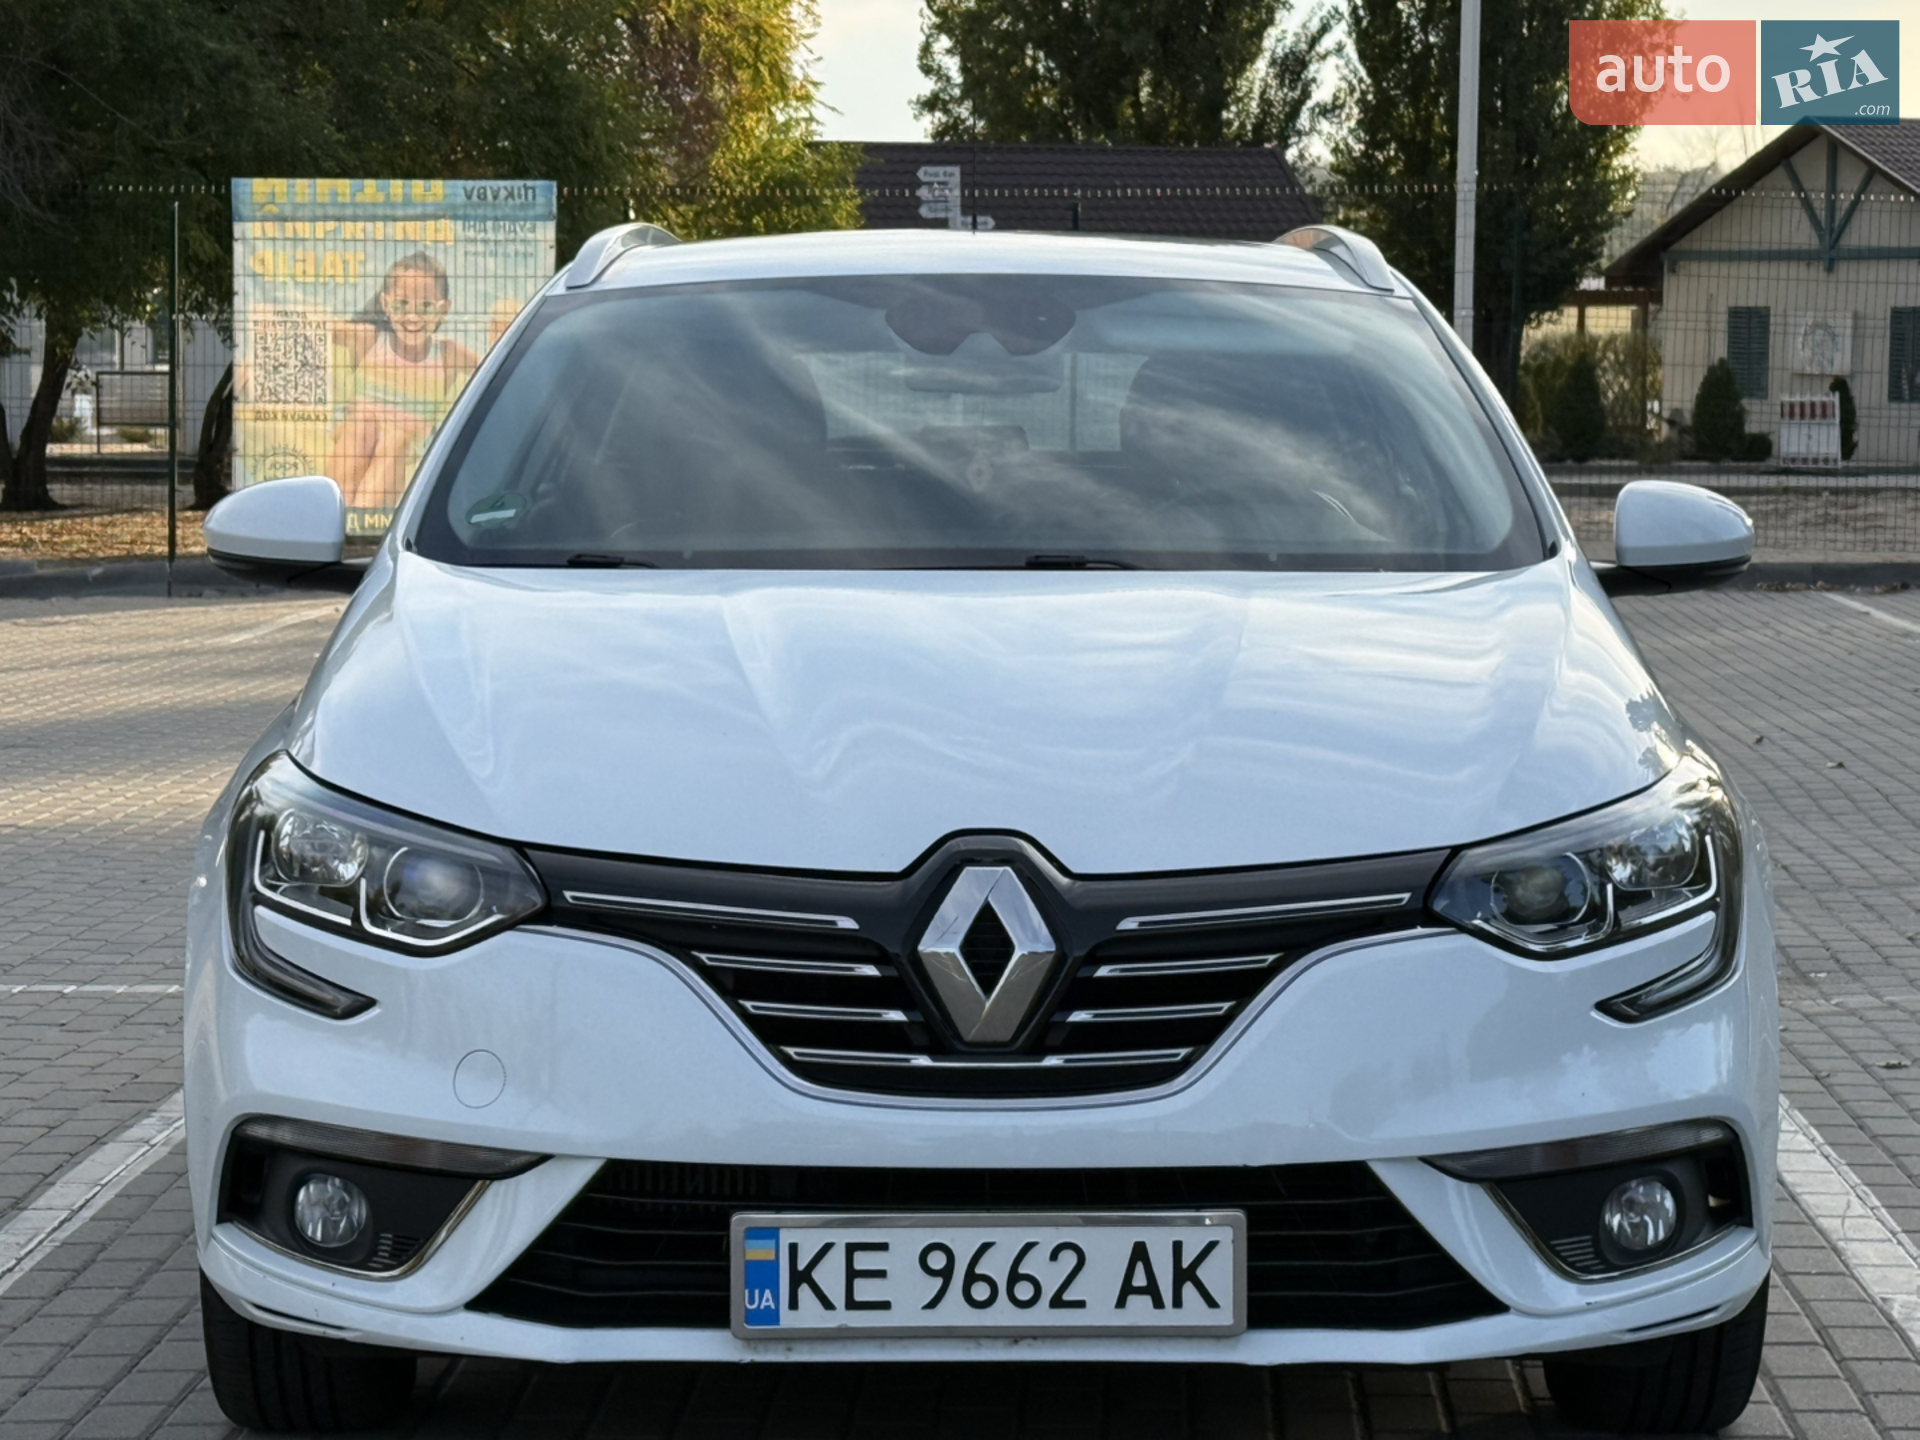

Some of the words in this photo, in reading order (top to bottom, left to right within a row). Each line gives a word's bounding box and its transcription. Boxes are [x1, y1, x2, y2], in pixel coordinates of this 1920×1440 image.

[788, 1241, 891, 1310] KE
[918, 1241, 1087, 1310] 9662
[1114, 1240, 1221, 1309] AK
[745, 1289, 775, 1310] UA
